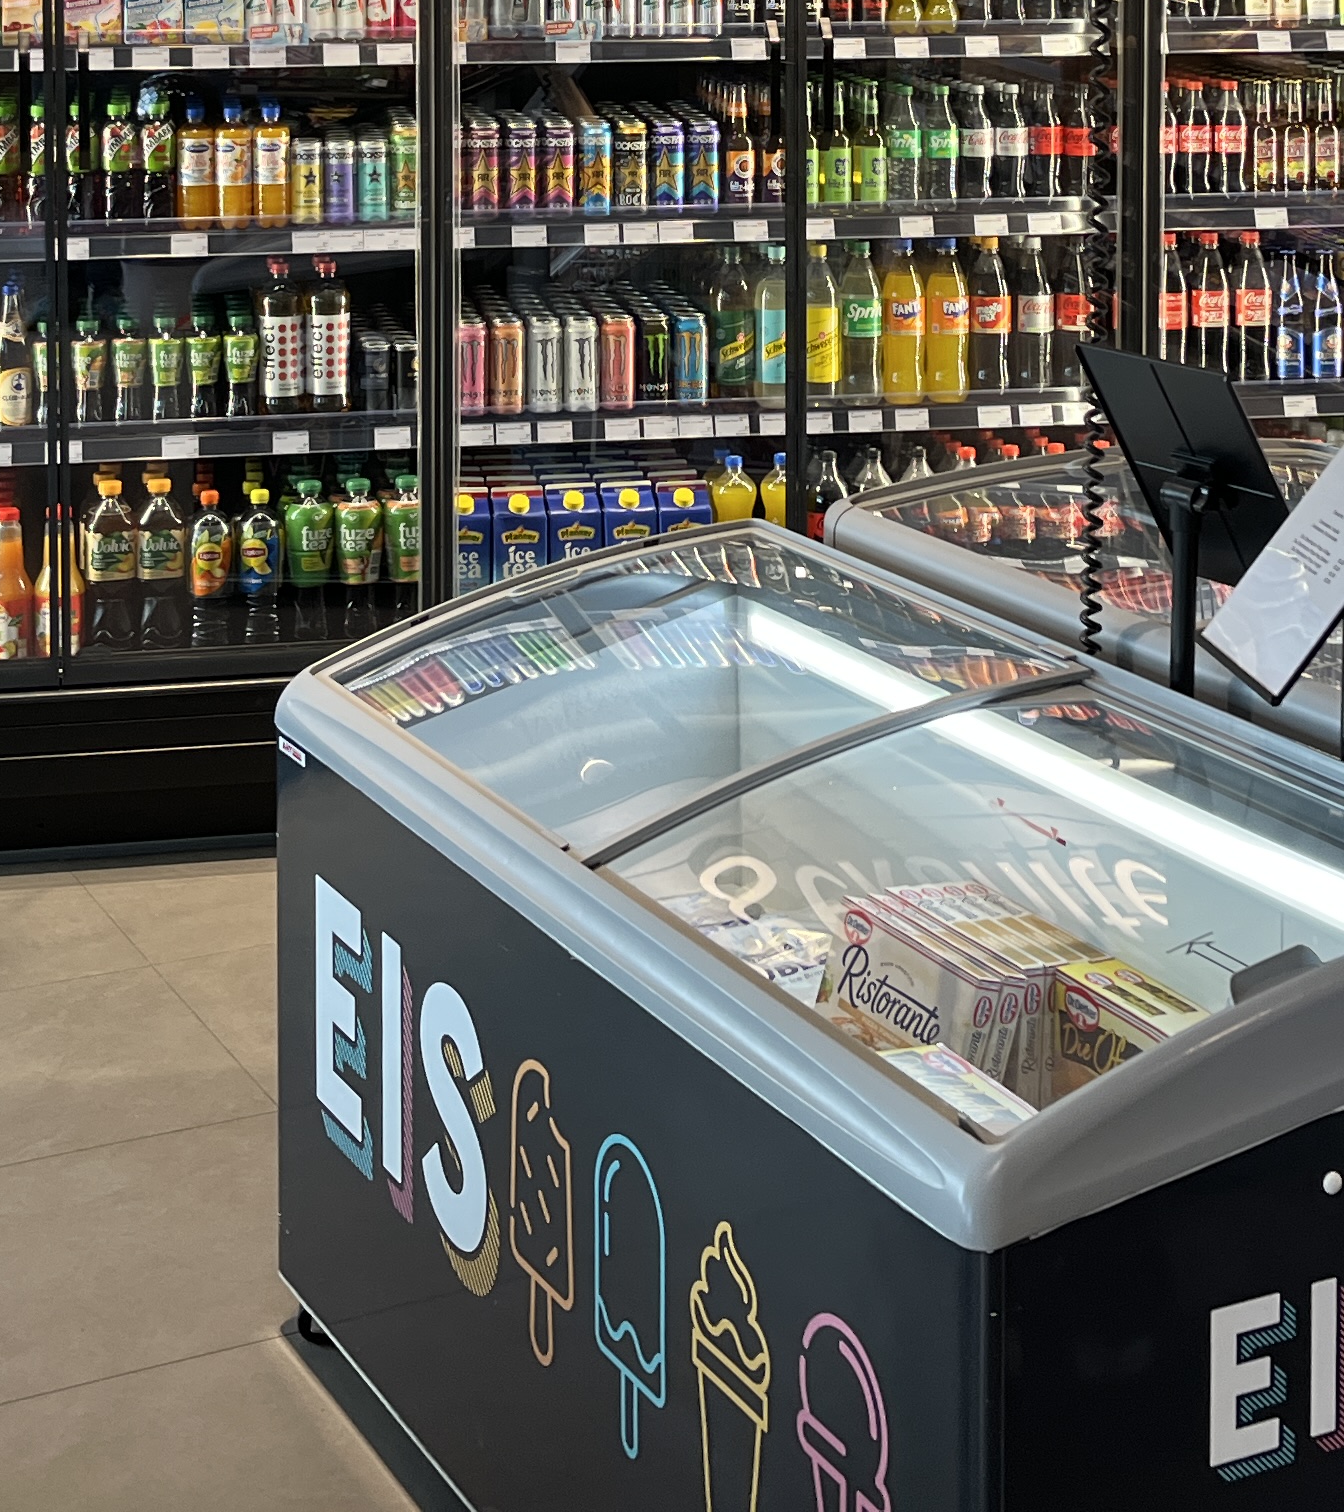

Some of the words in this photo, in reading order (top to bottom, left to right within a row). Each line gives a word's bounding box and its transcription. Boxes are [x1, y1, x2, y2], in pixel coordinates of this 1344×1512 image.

[892, 301, 921, 315] FANT
[942, 300, 969, 315] FANT
[264, 323, 276, 381] effect
[312, 323, 324, 380] effect
[302, 525, 333, 541] fuze
[340, 524, 375, 542] fuze
[399, 524, 419, 541] fuz
[92, 538, 135, 554] Volvic
[143, 537, 184, 553] Volvic
[301, 538, 329, 552] tea
[340, 538, 367, 552] tea
[508, 545, 536, 563] ice
[837, 943, 943, 1045] Ristorante
[315, 874, 494, 1263] EIS
